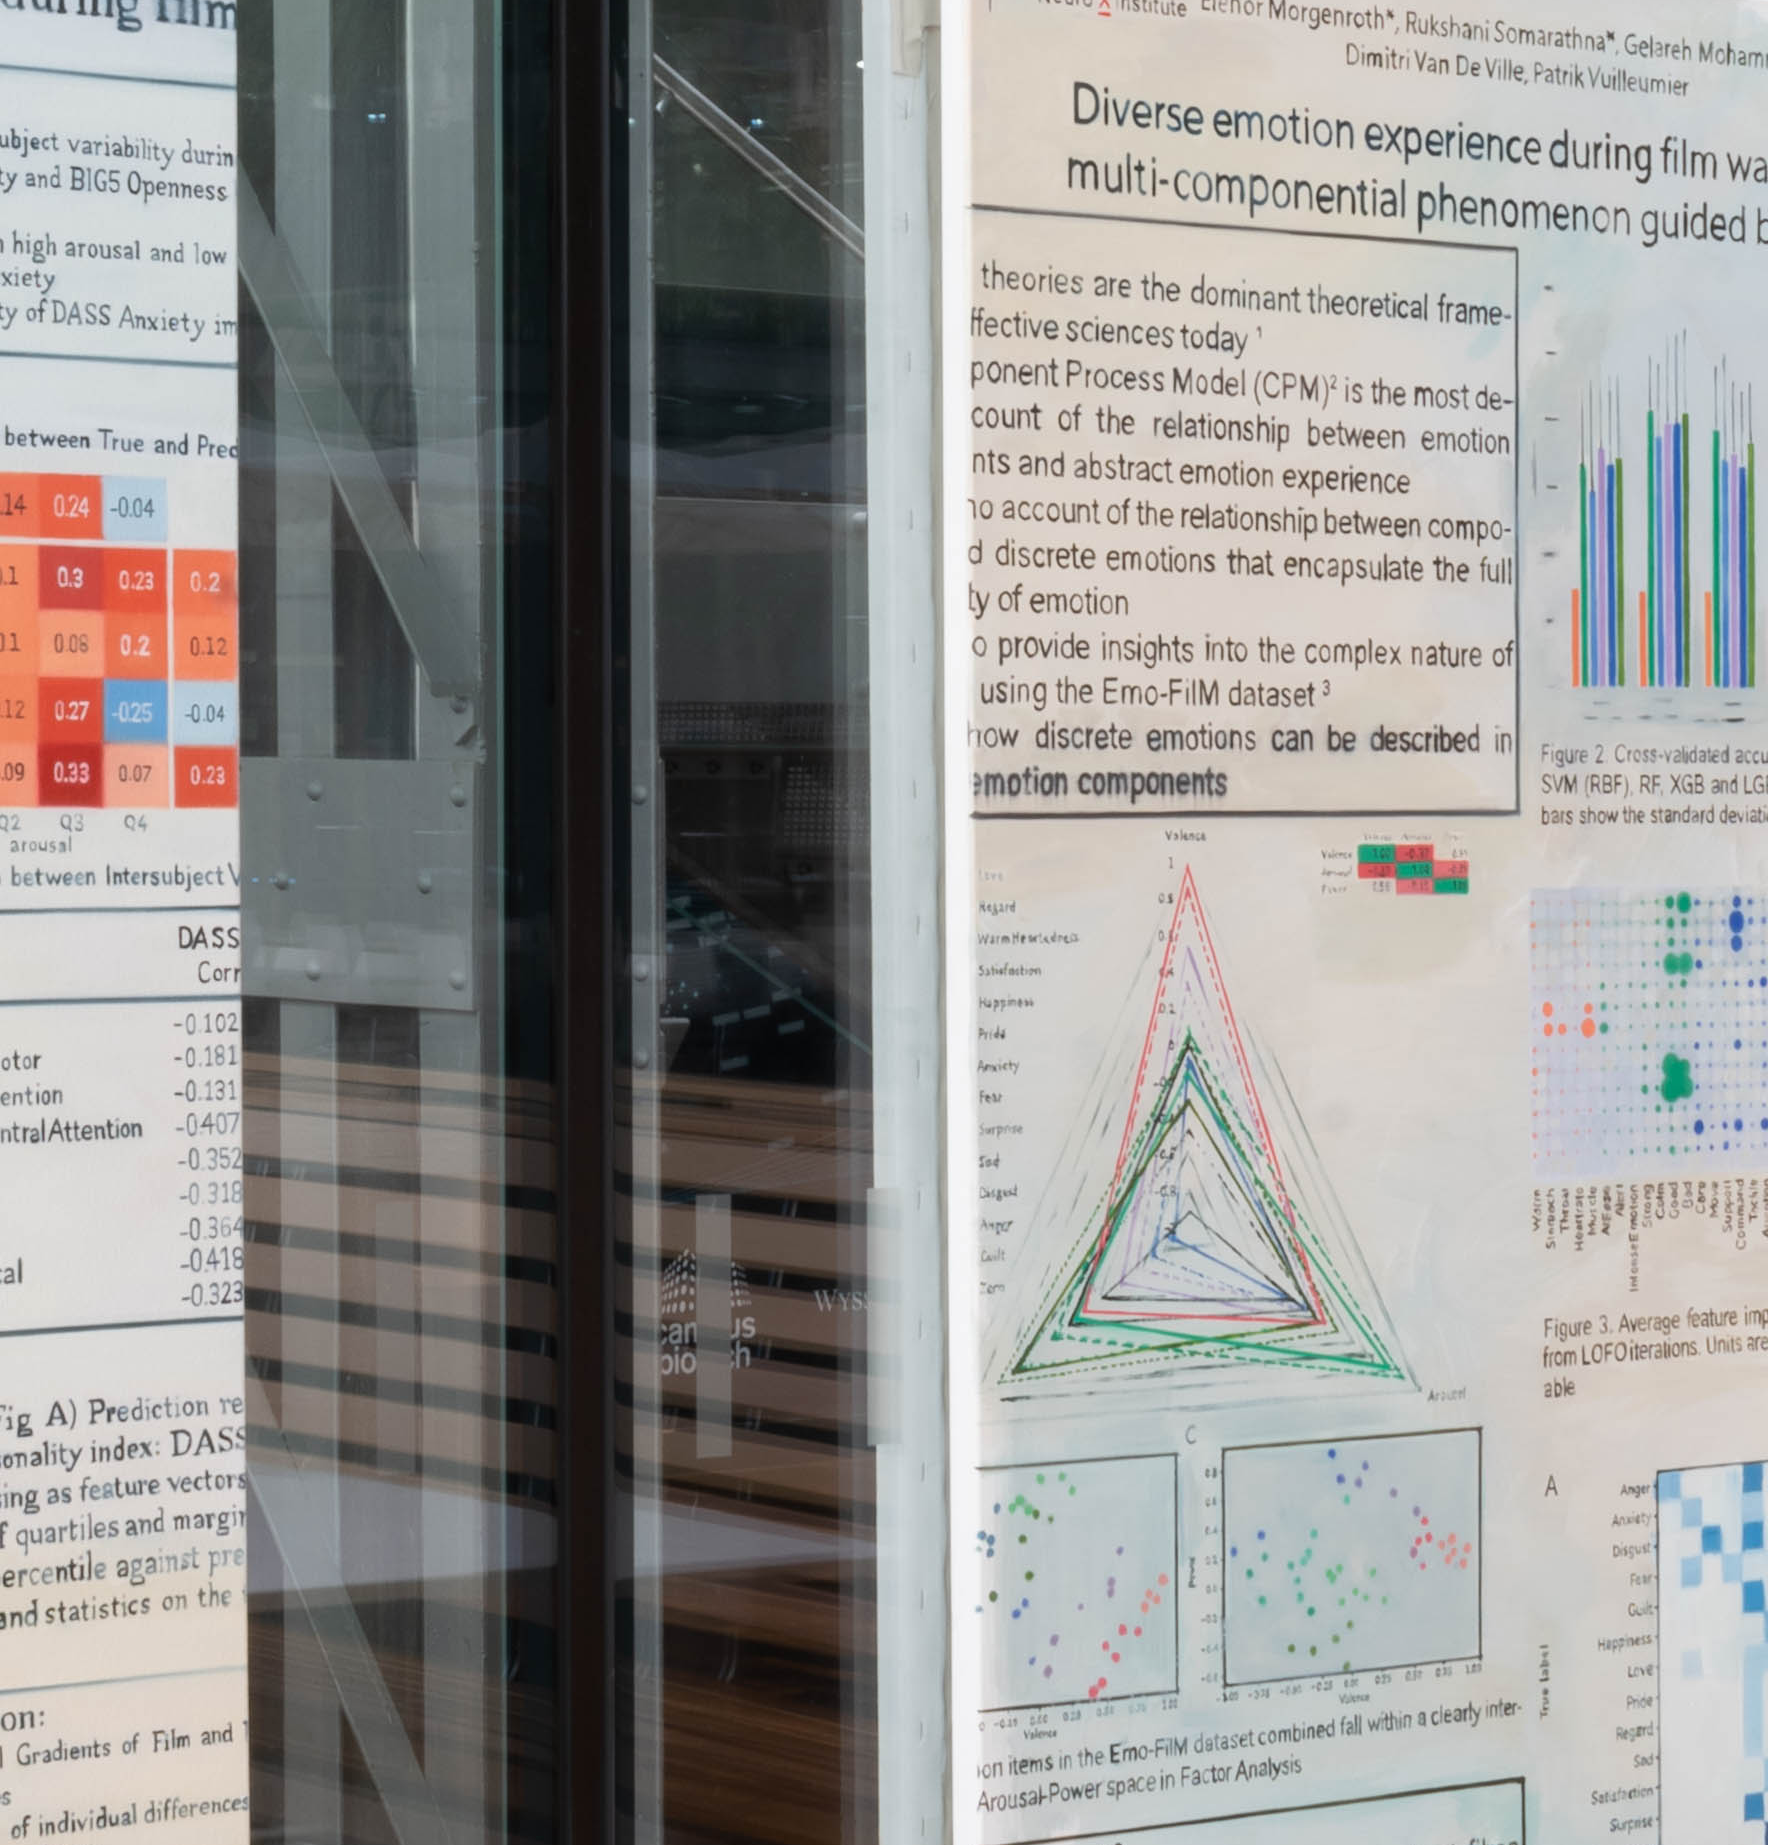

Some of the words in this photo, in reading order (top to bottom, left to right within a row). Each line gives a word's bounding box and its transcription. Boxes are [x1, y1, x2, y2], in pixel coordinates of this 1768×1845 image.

[1405, 10, 1490, 42] Rukshani
[1624, 32, 1692, 61] Gelareh
[1345, 42, 1410, 70] Dimitri
[1414, 50, 1450, 75] Van
[1455, 54, 1481, 77] De
[1484, 57, 1529, 85] Ville,
[1533, 61, 1585, 89] Patrik
[1587, 66, 1689, 97] Vuilleumier
[67, 135, 175, 172] variability
[1073, 81, 1204, 136] Diverse
[1212, 107, 1355, 150] emotion
[1364, 121, 1542, 166] experience
[1548, 128, 1652, 185] during
[1659, 135, 1718, 180] film
[1067, 153, 1406, 218] multi-componential
[1417, 181, 1631, 236] phenomenon
[1640, 201, 1746, 248] guided
[981, 259, 1084, 295] theories
[1093, 275, 1132, 299] are
[1140, 271, 1181, 303] the
[1190, 273, 1302, 314] dominant
[1306, 283, 1429, 322] theoretical
[1437, 292, 1512, 326] frame-
[4, 424, 91, 449] between
[97, 427, 145, 453] True
[154, 432, 189, 456] and
[53, 493, 90, 518] 0.24
[109, 495, 155, 519] -0.04
[980, 675, 1047, 712] using
[1055, 675, 1094, 705] the
[1228, 679, 1316, 709] dataset
